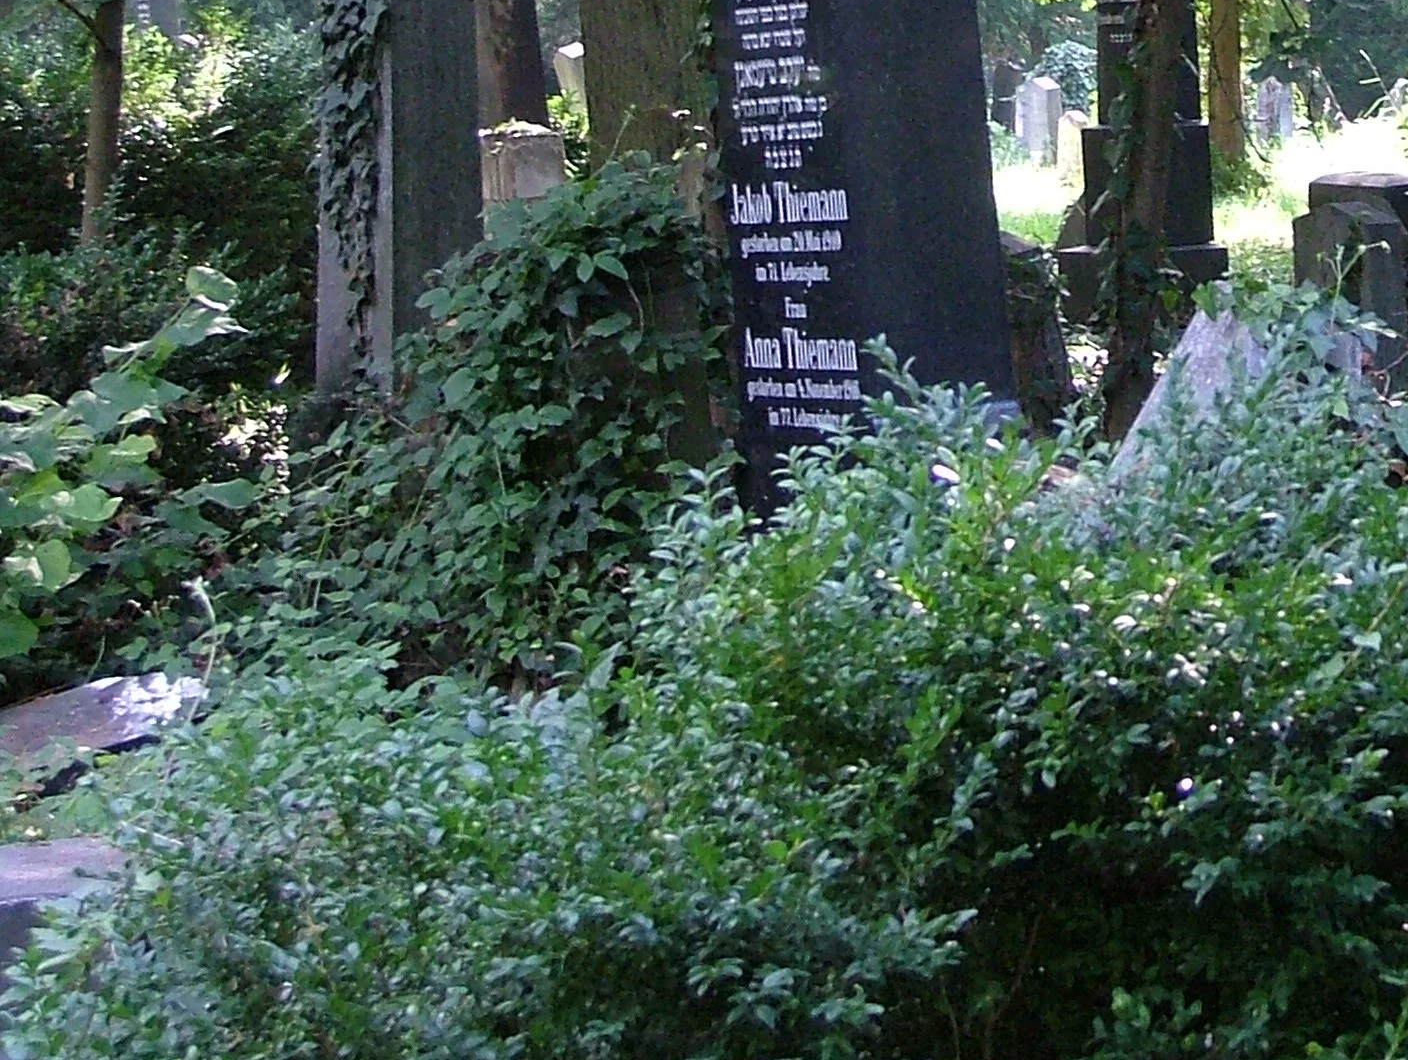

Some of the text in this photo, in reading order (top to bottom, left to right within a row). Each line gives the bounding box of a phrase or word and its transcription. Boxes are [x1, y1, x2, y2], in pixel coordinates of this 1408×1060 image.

[730, 181, 849, 224] Jakob Thiemann
[744, 326, 858, 371] Anna Thiemann
